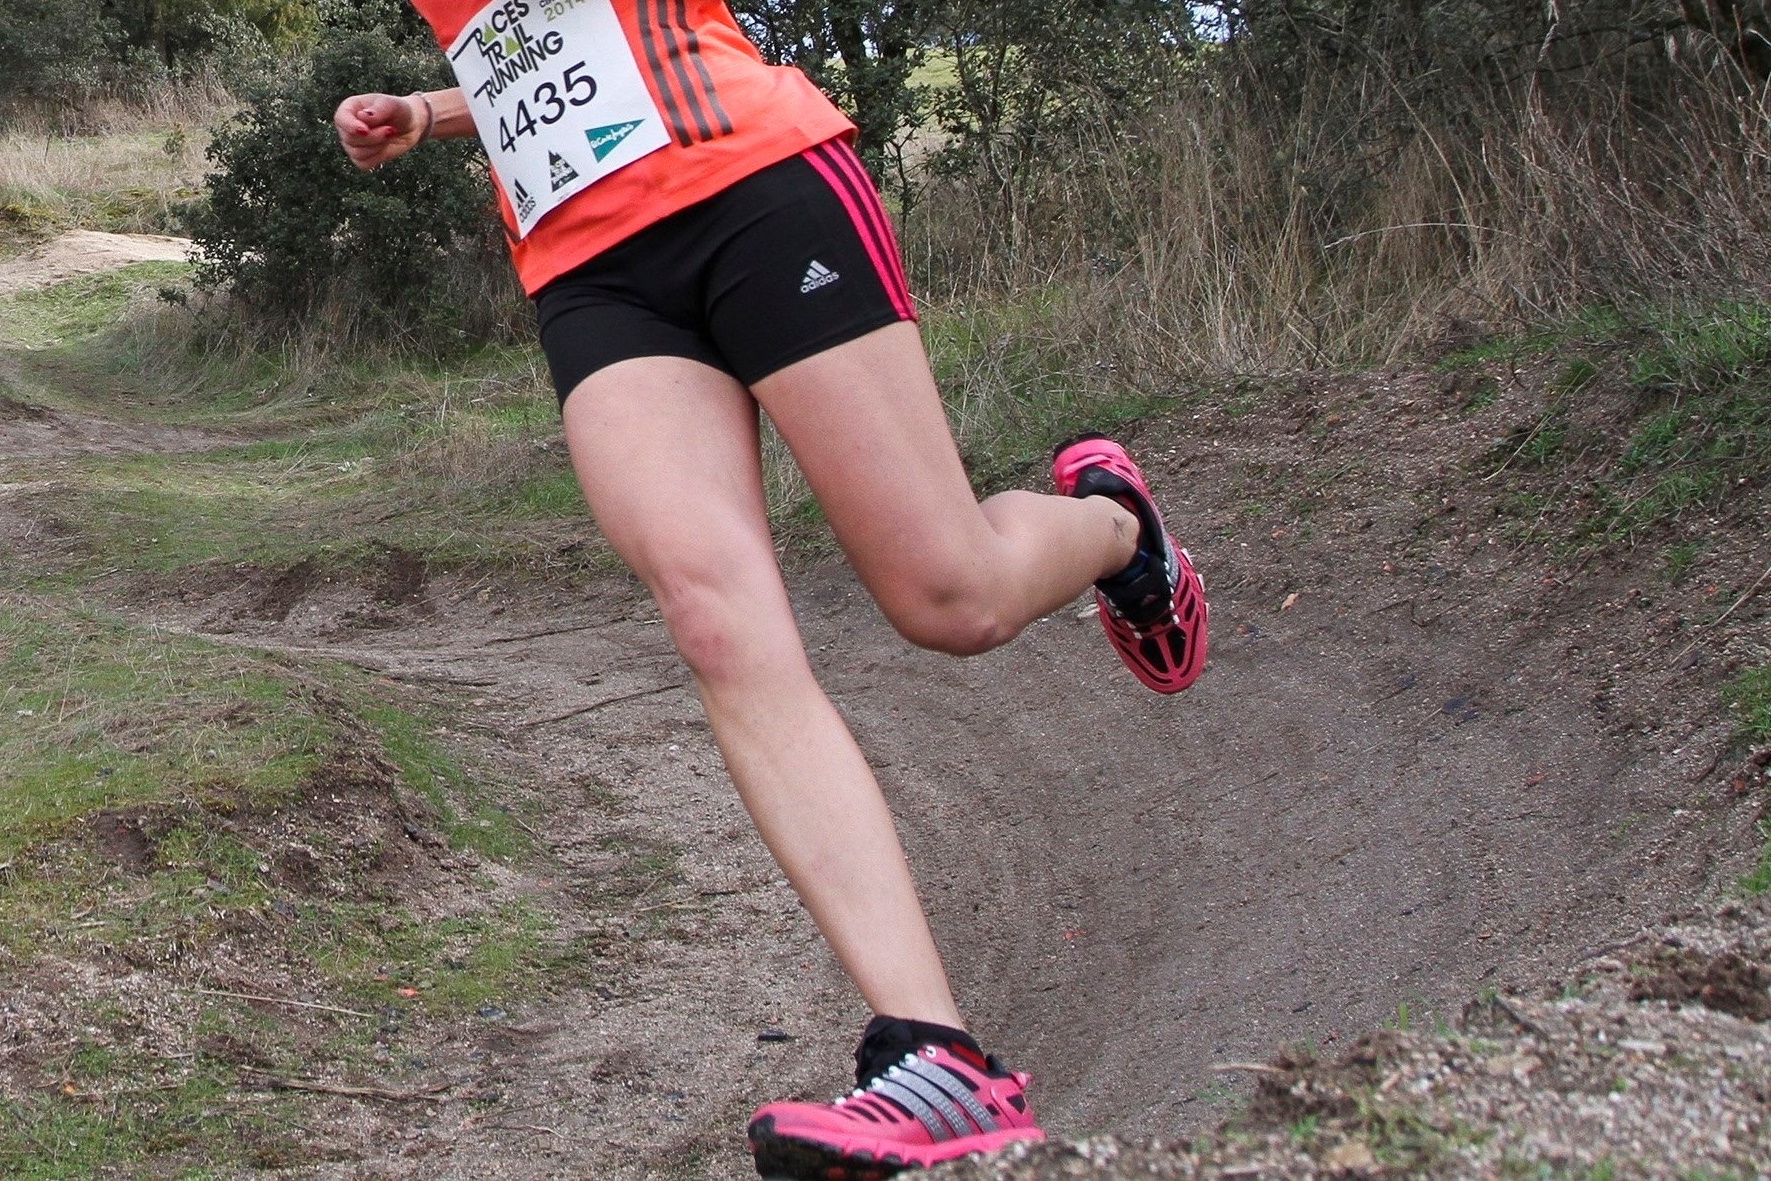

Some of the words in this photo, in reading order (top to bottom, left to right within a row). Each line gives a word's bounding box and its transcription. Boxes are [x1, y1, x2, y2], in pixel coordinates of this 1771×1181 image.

[474, 31, 564, 108] RUNNING
[498, 60, 598, 154] 4435
[800, 271, 840, 294] adidas
